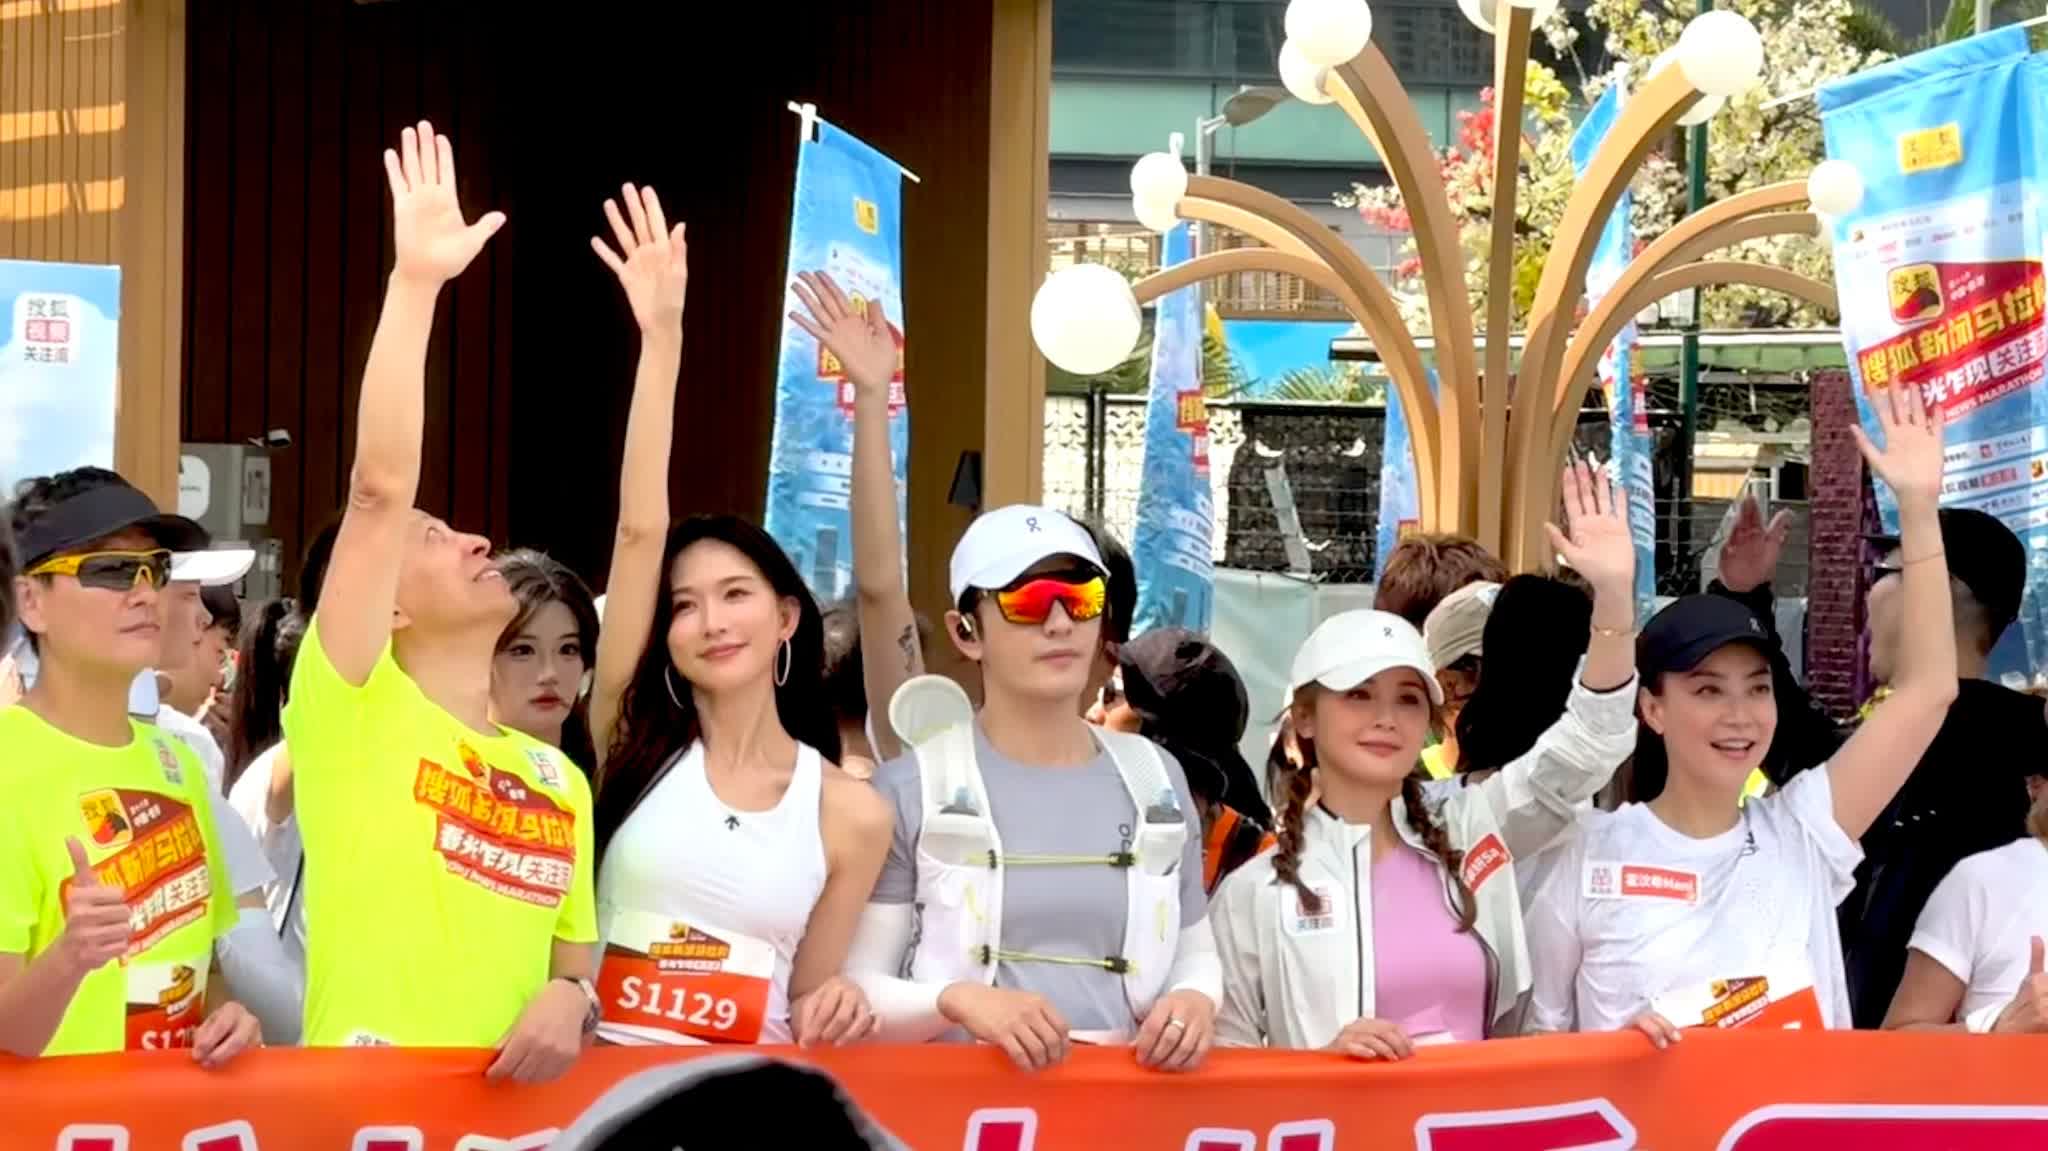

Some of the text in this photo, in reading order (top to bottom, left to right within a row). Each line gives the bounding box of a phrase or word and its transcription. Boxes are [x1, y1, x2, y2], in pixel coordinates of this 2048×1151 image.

[1906, 331, 2047, 408] 光乍现关注
[616, 975, 737, 1030] S1129
